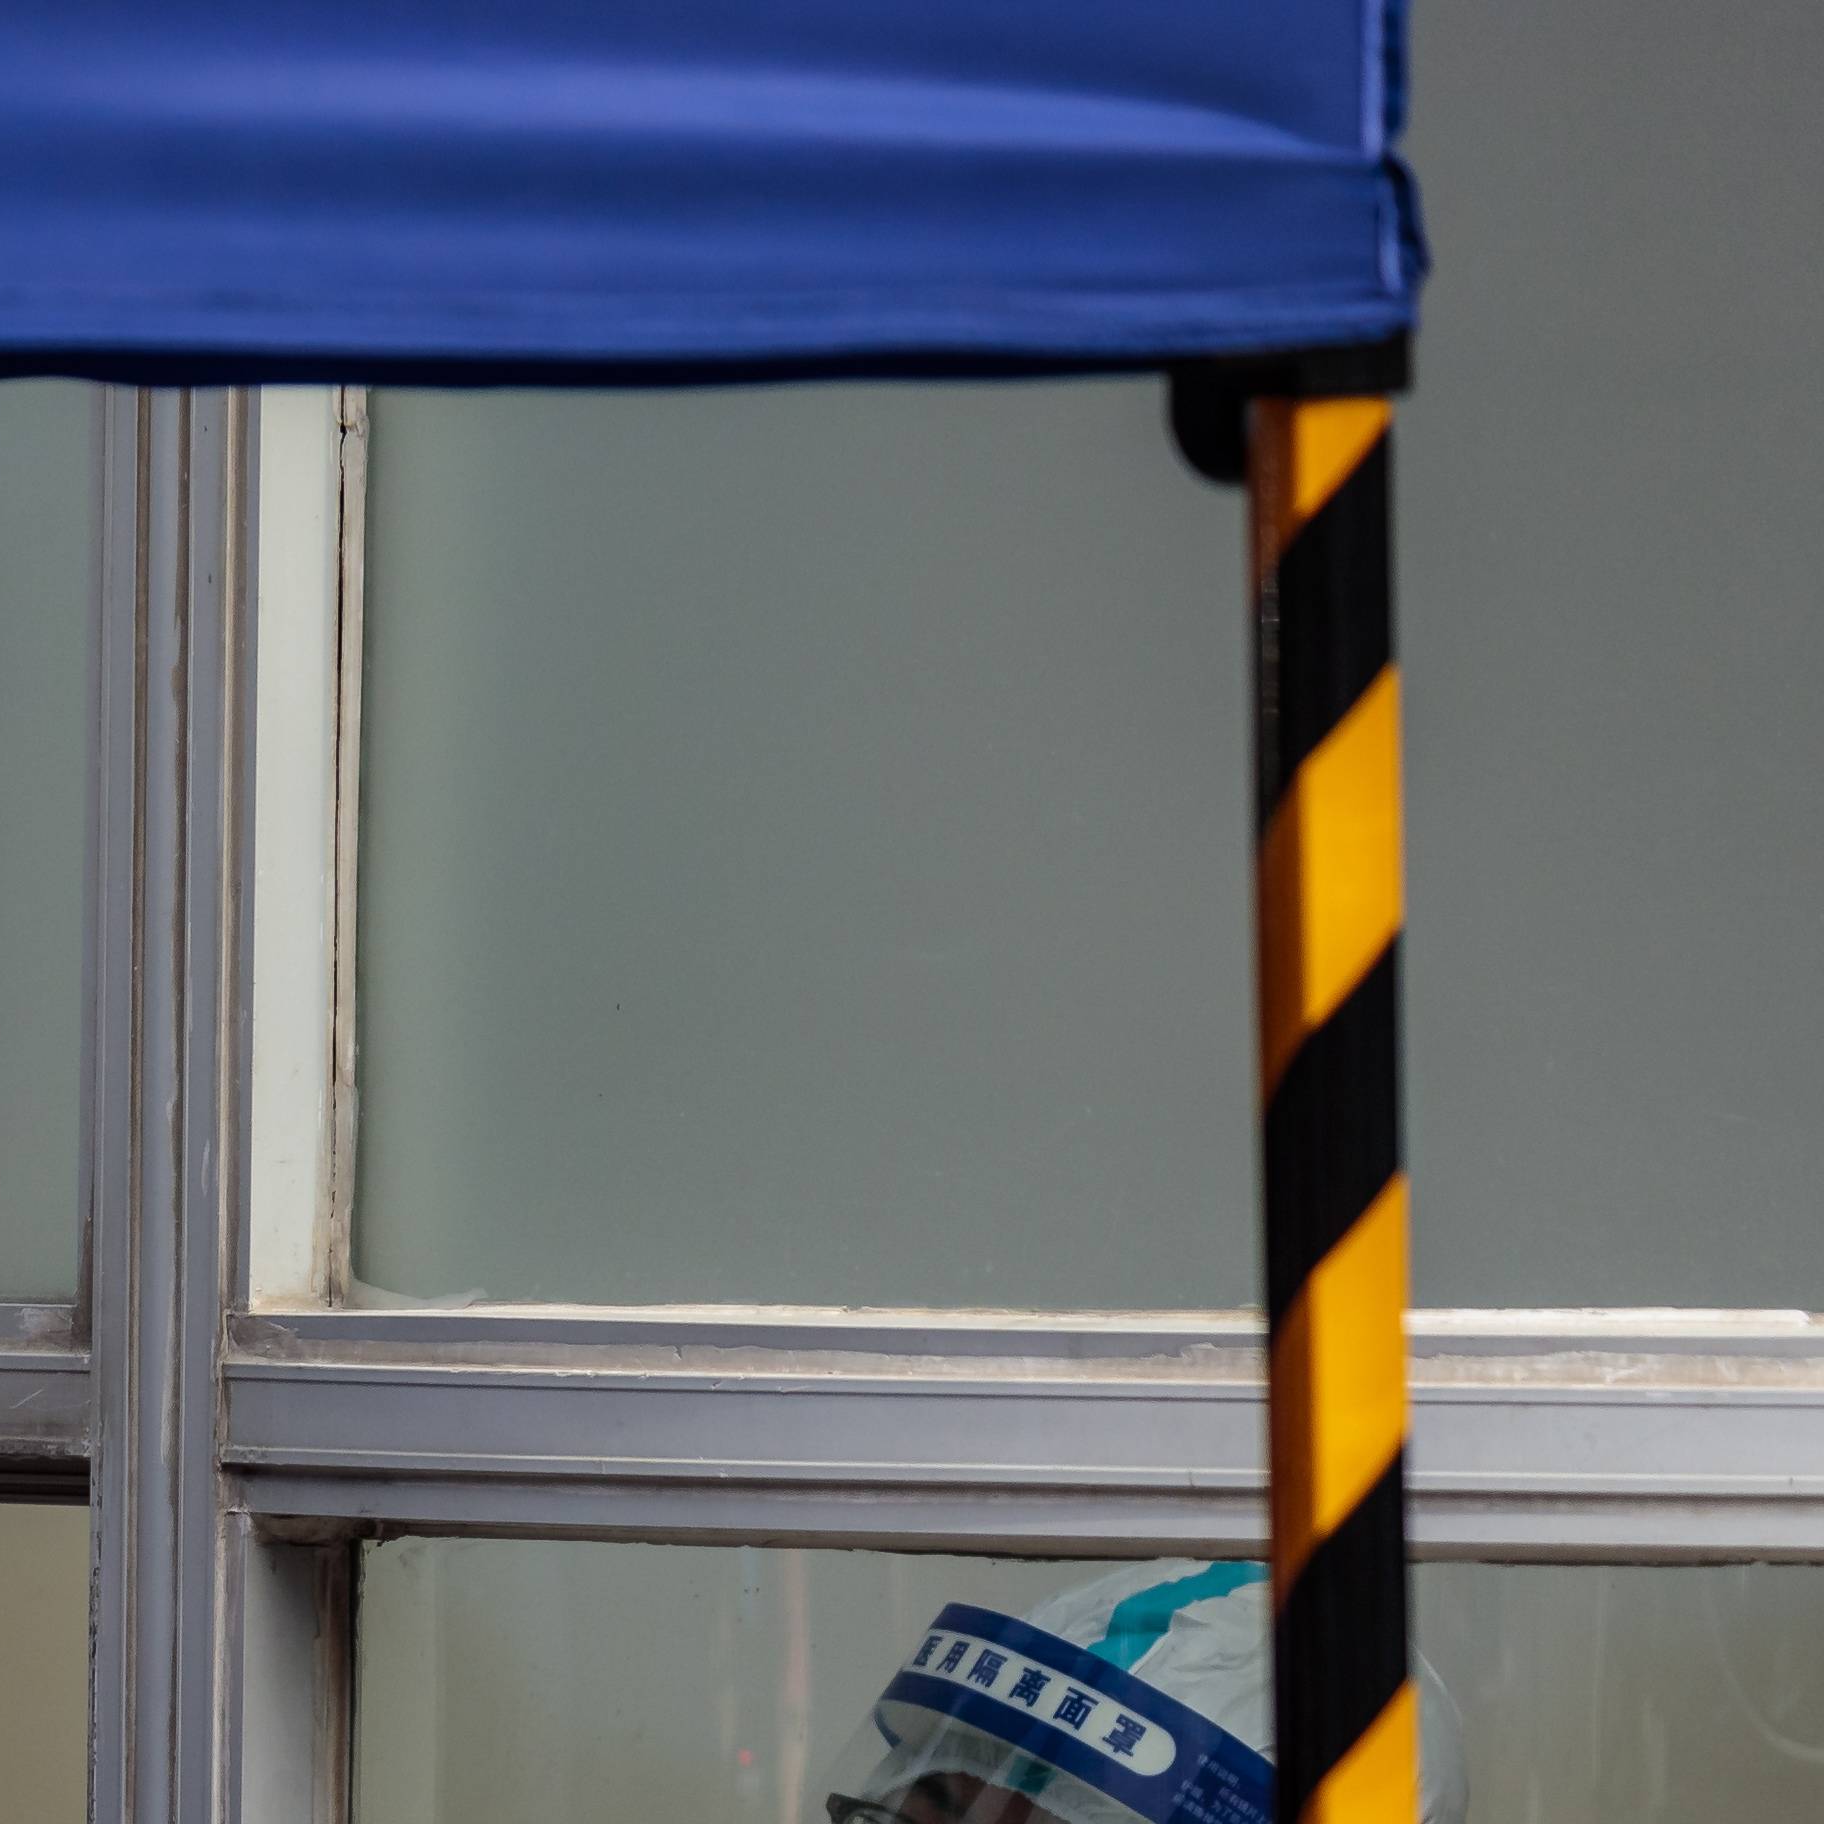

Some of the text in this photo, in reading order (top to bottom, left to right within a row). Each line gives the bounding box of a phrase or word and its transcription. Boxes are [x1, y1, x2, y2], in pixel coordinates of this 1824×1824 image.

[912, 1635, 1147, 1757] 医用隔离面罩
